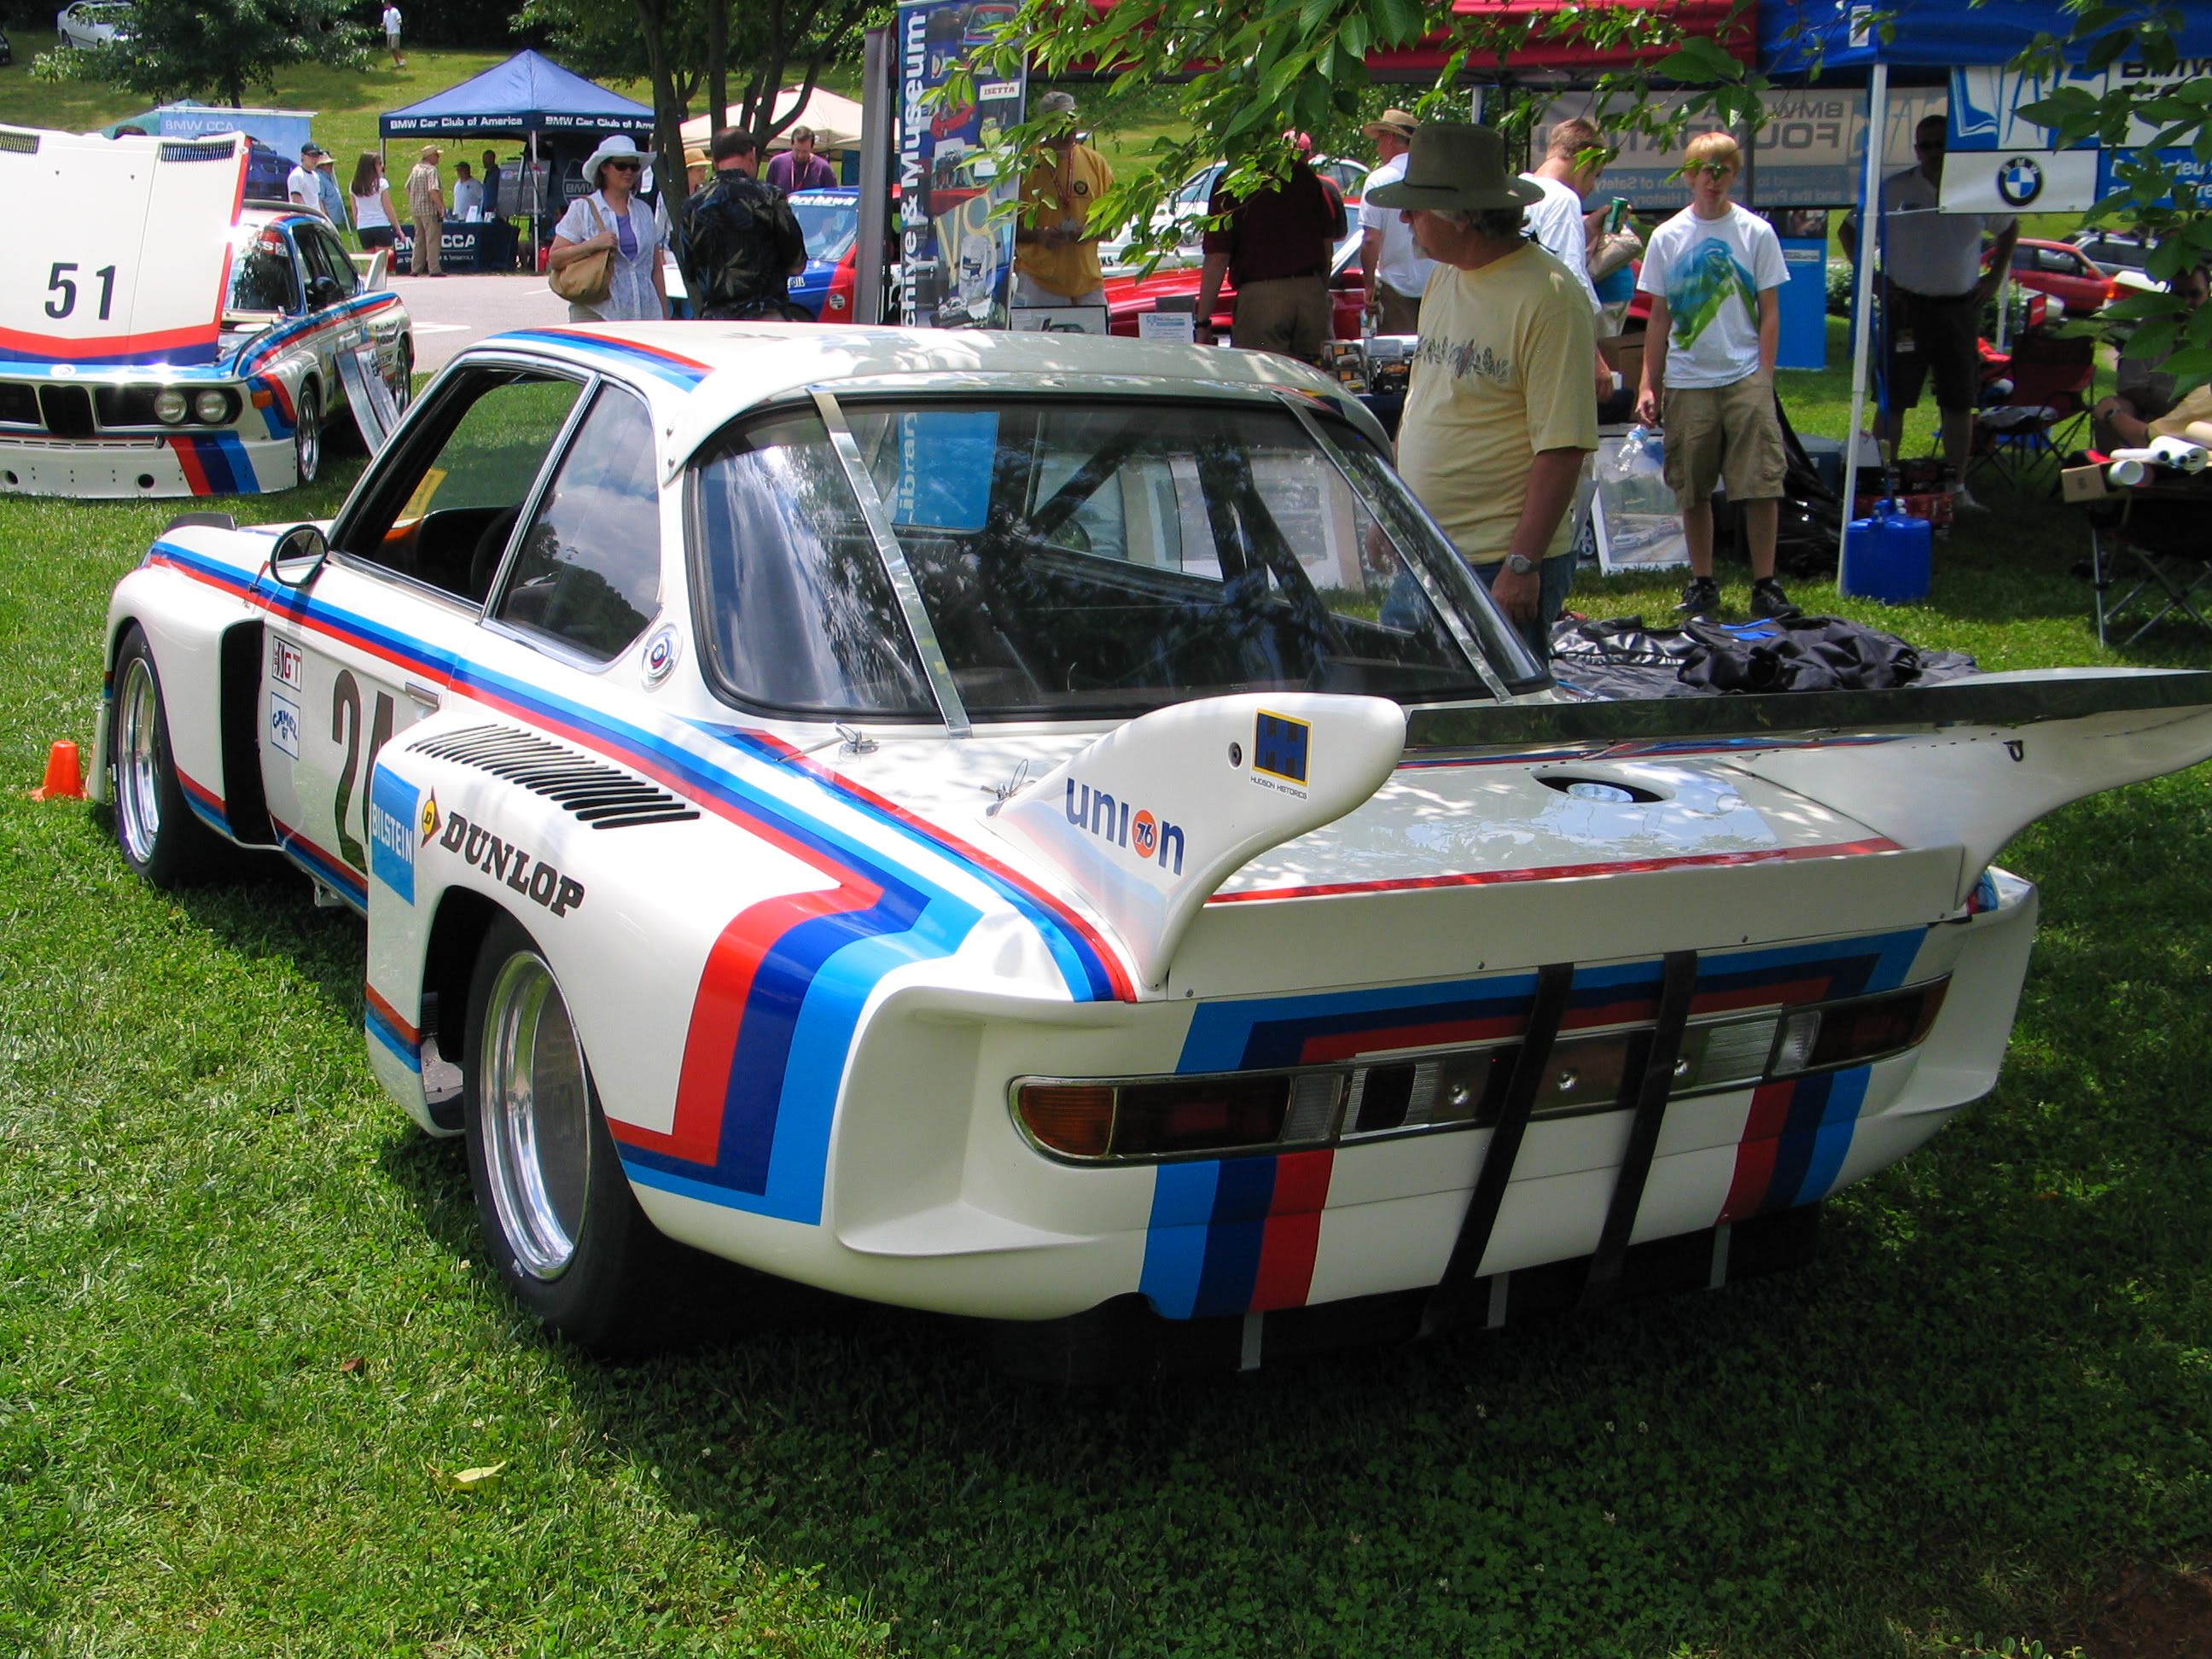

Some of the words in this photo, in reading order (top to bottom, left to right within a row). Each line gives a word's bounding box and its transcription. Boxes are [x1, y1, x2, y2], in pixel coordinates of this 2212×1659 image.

[901, 14, 927, 189] Museum
[984, 86, 1015, 96] ISETTA
[166, 119, 203, 131] BMW
[206, 121, 235, 131] CCA
[390, 119, 417, 130] BMW
[420, 118, 439, 128] Car
[441, 117, 464, 127] Club
[467, 116, 478, 126] of
[480, 116, 523, 126] America
[544, 115, 573, 126] BMW
[575, 117, 594, 126] Car
[597, 118, 620, 128] Club
[622, 120, 632, 129] of
[901, 194, 918, 221] &
[441, 234, 475, 248] CCA
[44, 262, 116, 321] 51
[283, 651, 301, 684] GT
[272, 709, 298, 742] CAMEL
[282, 726, 289, 742] GT
[1250, 775, 1276, 789] HUDSON
[1277, 783, 1307, 800] HISTORICS
[423, 810, 433, 825] D
[372, 802, 413, 865] BILSTEIN
[1136, 823, 1153, 848] 76
[439, 811, 585, 918] DUNLOP
